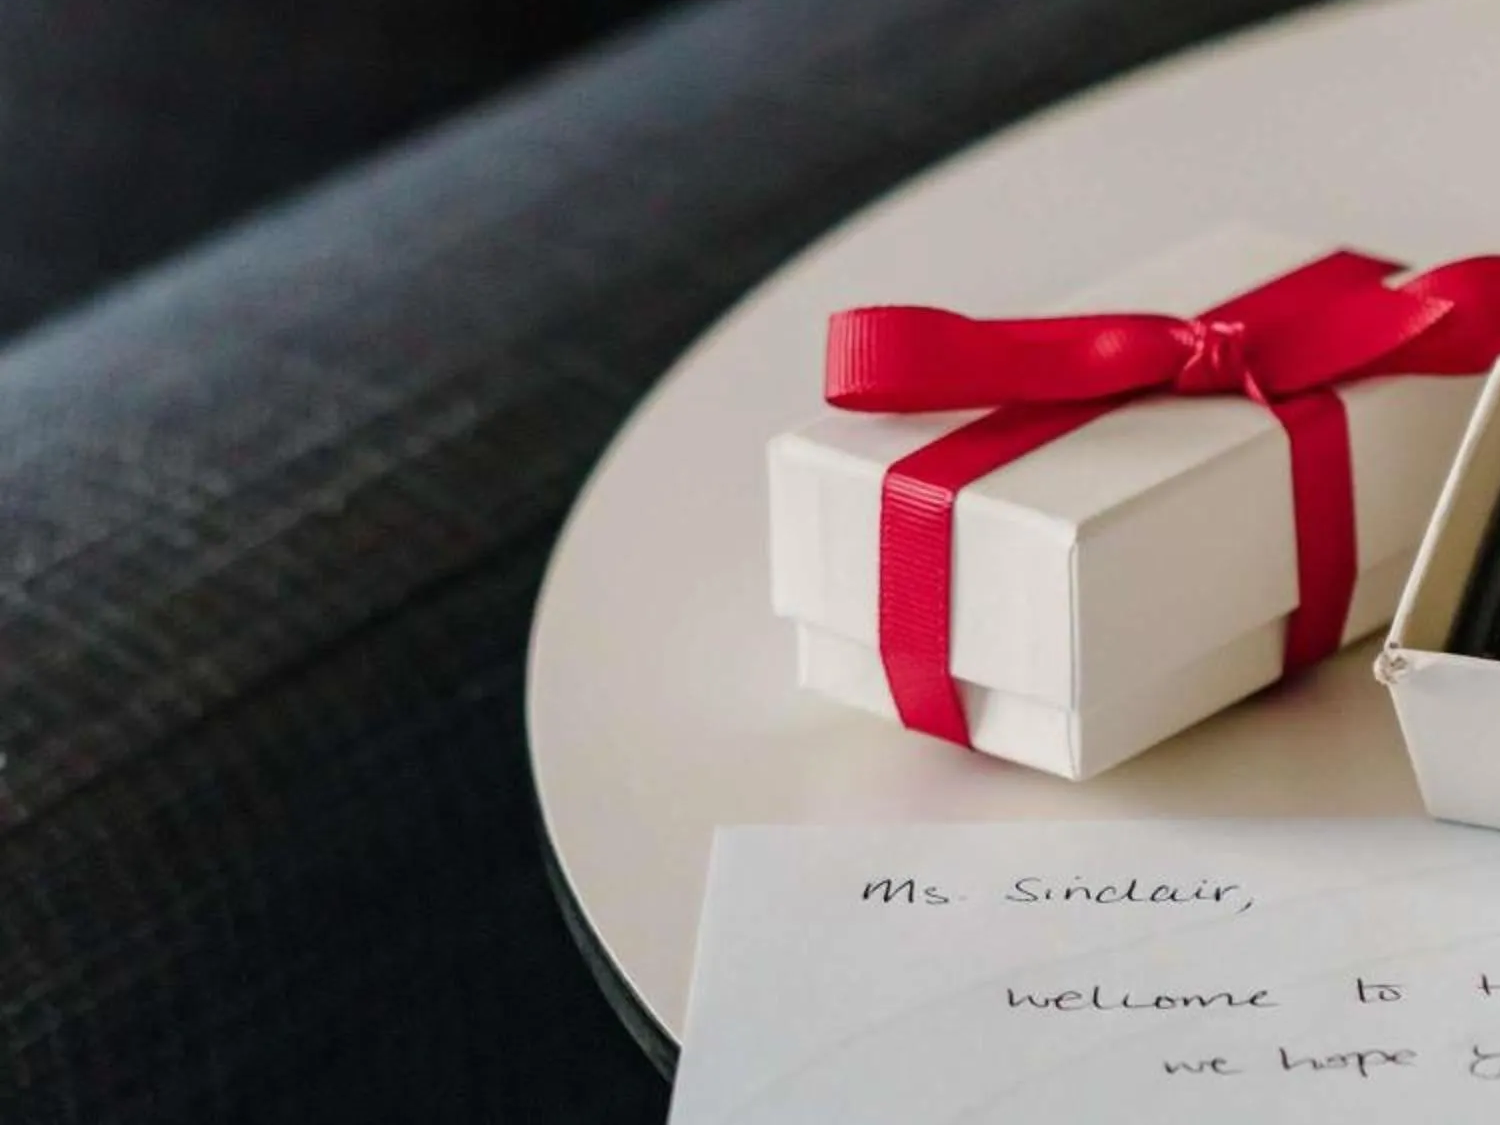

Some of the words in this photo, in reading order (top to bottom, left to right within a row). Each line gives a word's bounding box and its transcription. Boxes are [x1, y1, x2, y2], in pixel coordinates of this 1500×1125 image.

[1004, 876, 1256, 913] Sinclair,
[1356, 978, 1403, 1005] to
[1162, 1055, 1244, 1076] we
[1278, 1046, 1419, 1077] hope
